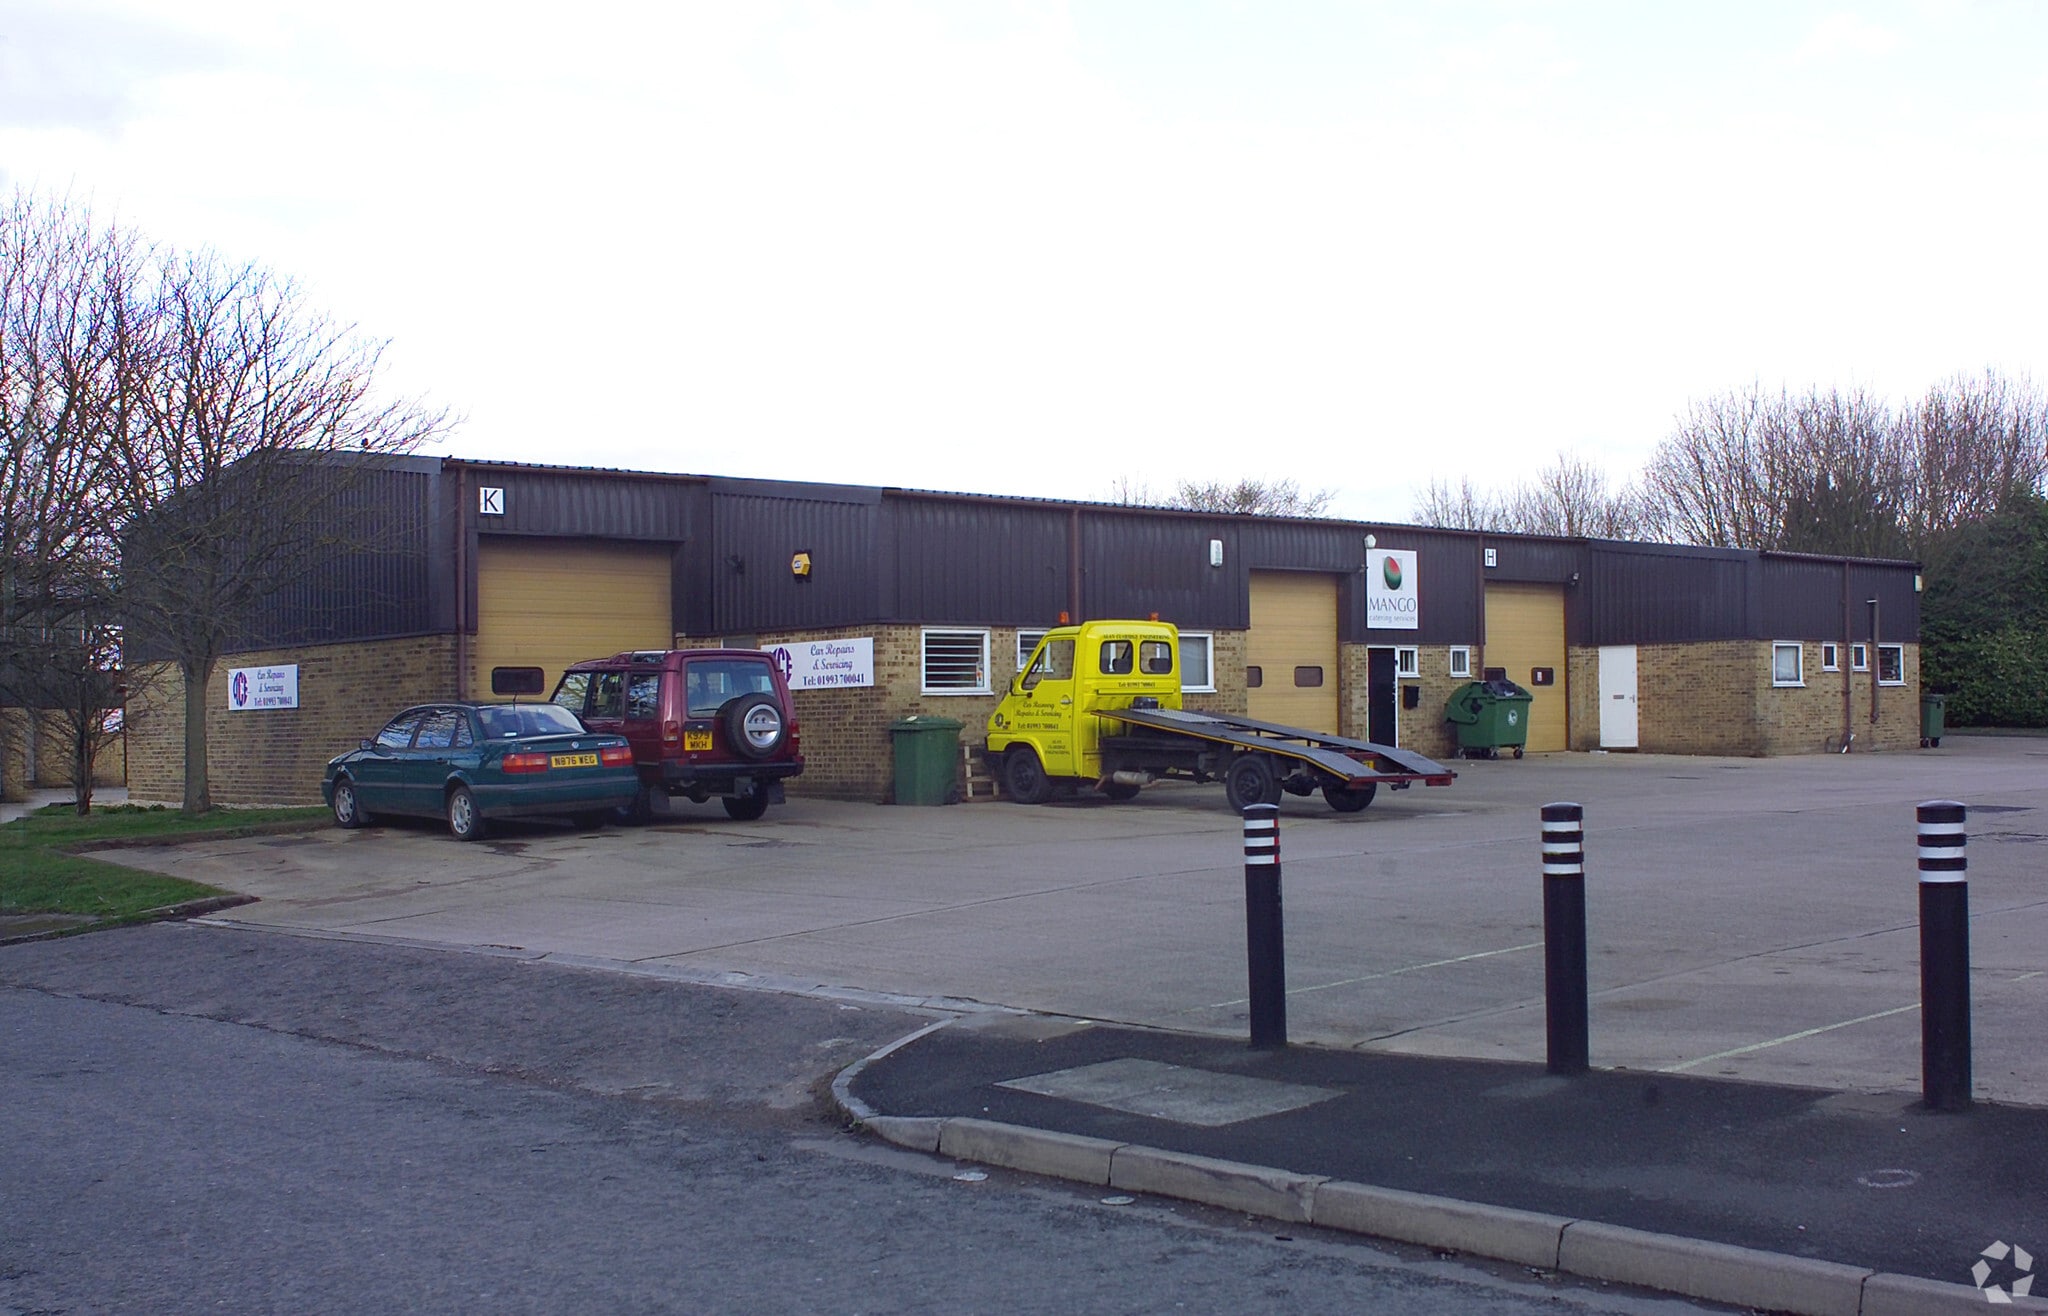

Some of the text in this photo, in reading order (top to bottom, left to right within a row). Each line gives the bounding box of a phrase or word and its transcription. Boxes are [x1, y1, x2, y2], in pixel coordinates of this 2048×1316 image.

[484, 489, 498, 512] K
[1486, 549, 1495, 565] H
[1368, 597, 1417, 613] MANGO
[1368, 615, 1416, 624] catering services
[810, 643, 855, 657] Car Repairs
[820, 658, 853, 671] Servicing
[803, 673, 865, 686] Tel: 01993 700041
[554, 755, 595, 766] N876 WEG
